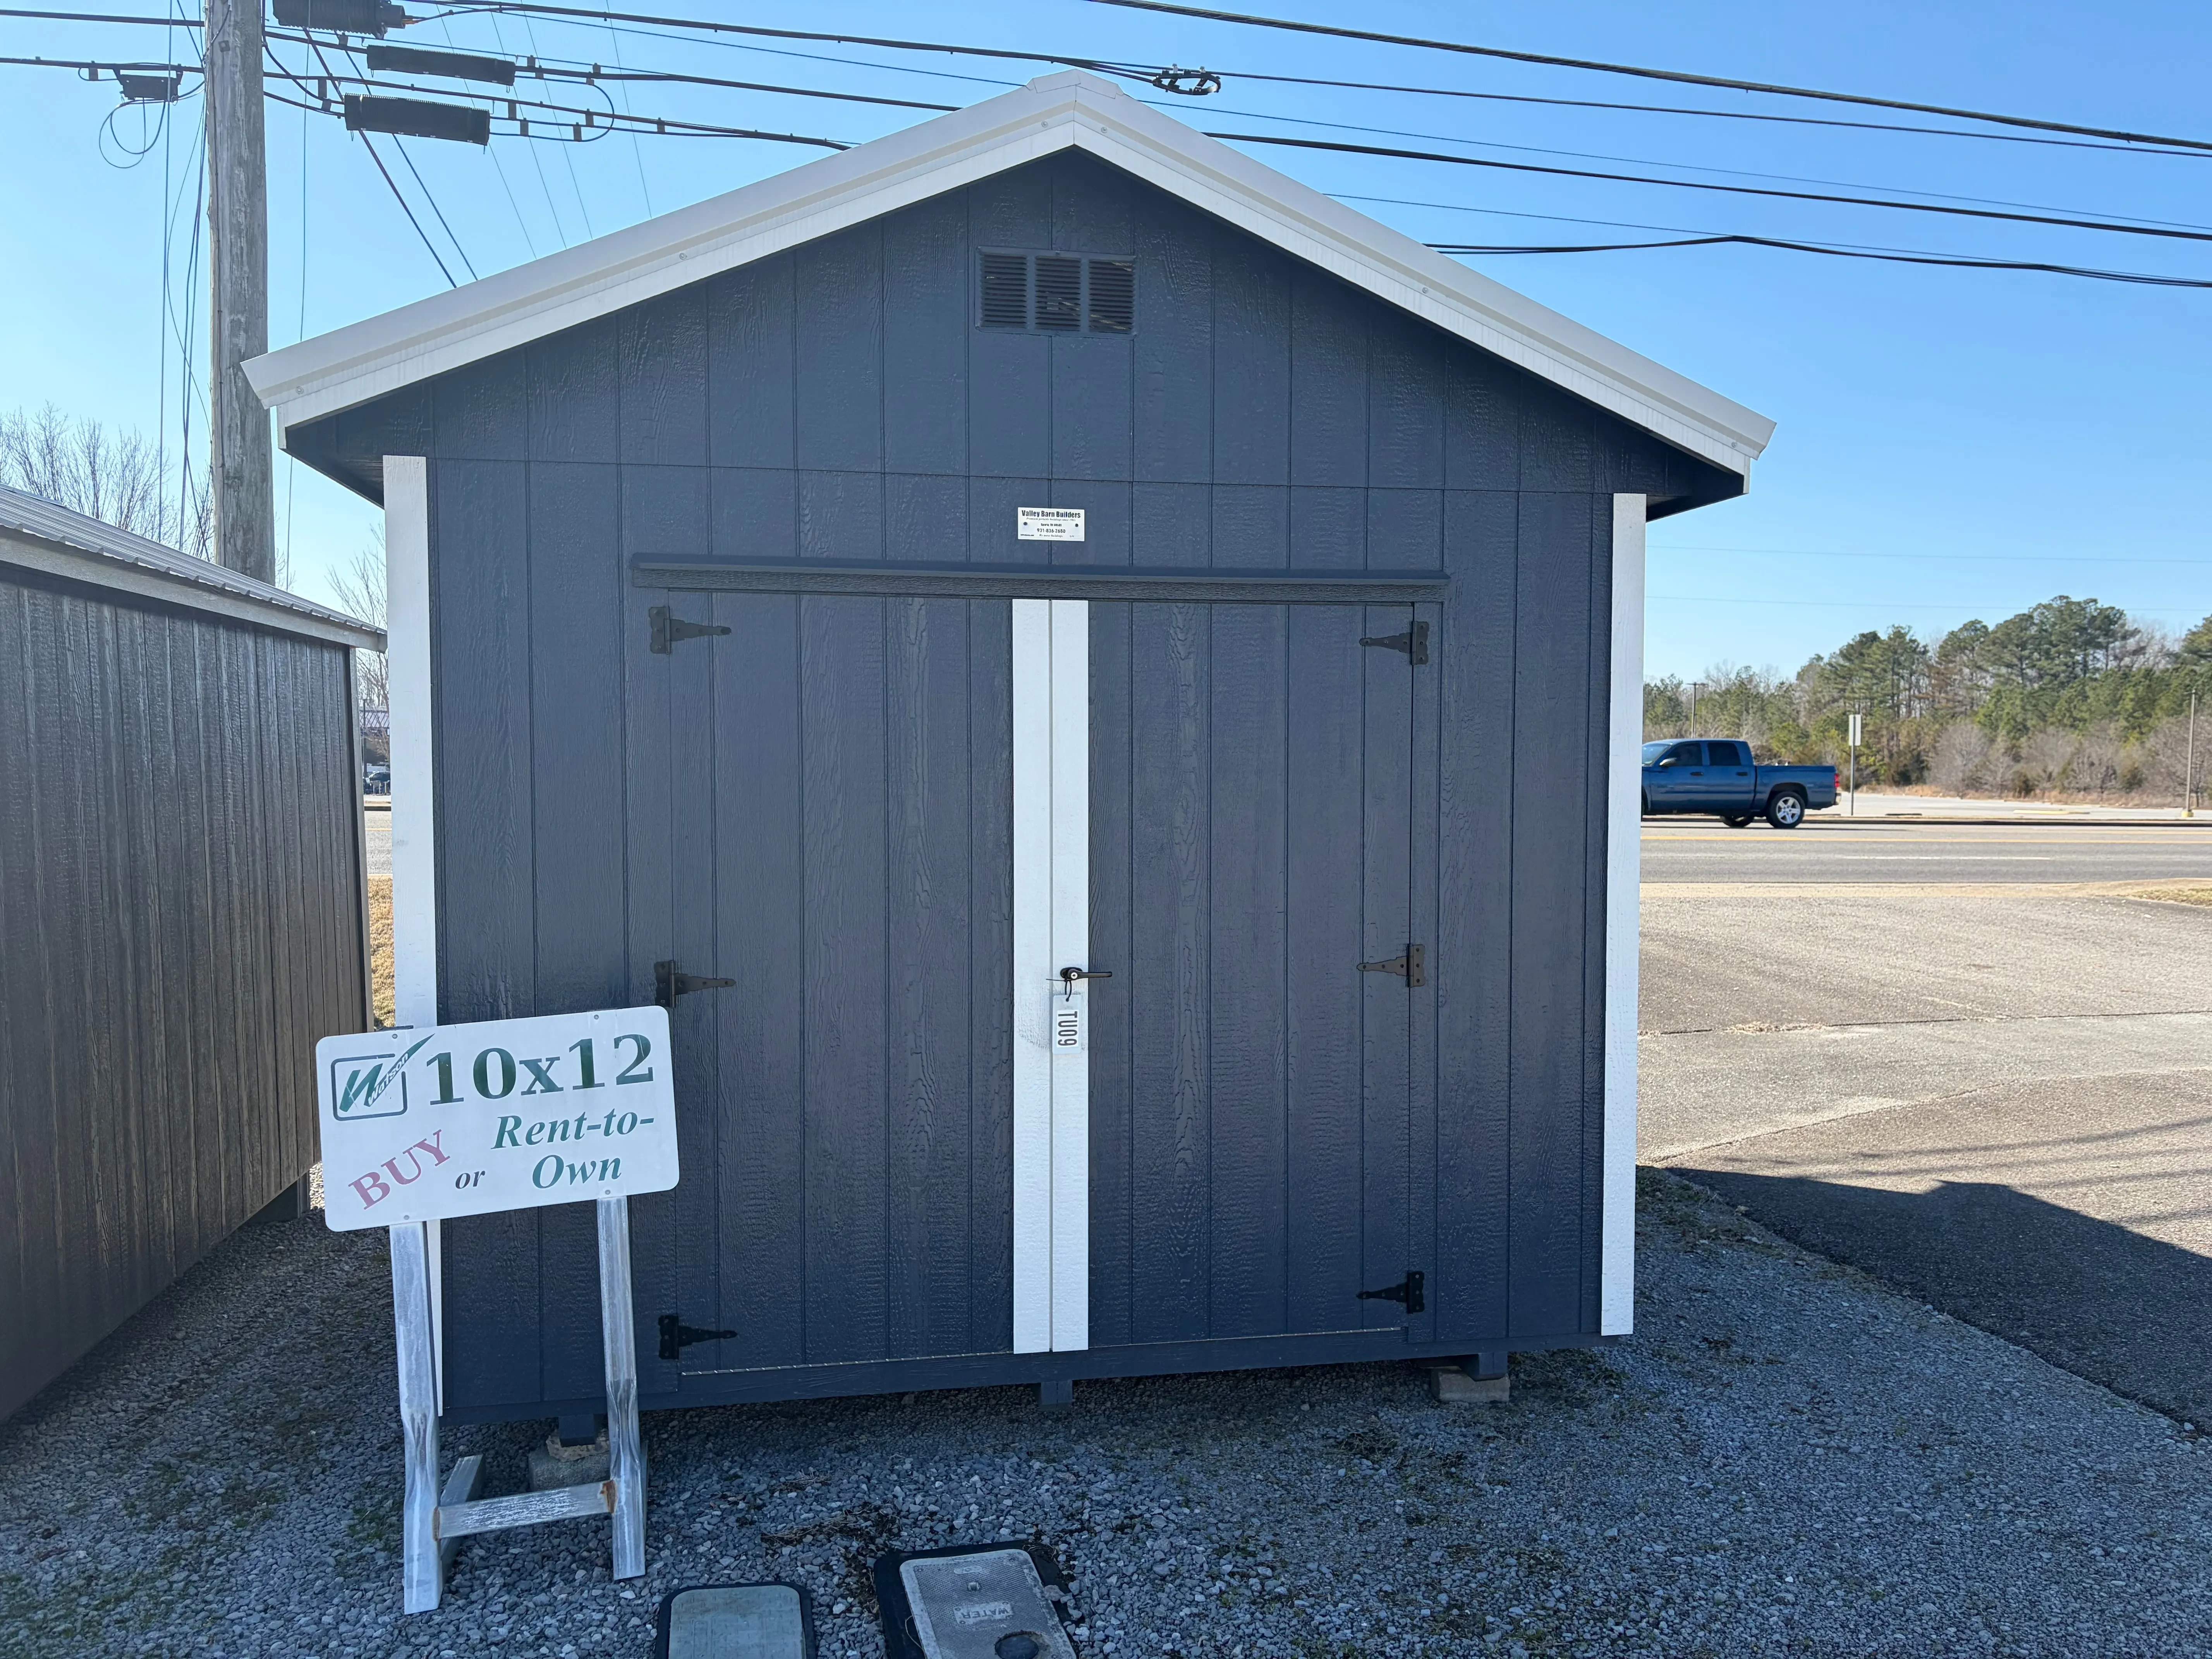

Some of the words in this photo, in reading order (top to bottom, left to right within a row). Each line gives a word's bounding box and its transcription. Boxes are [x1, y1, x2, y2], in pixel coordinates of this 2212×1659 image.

[1058, 1011, 1078, 1046] TU09
[368, 1052, 409, 1106] Watson
[426, 1034, 654, 1106] 10x12
[491, 1108, 654, 1149] Rent-to-
[348, 1129, 450, 1210] BUY
[455, 1169, 486, 1190] or
[532, 1154, 622, 1189] Own
[960, 1607, 1009, 1619] WATER
